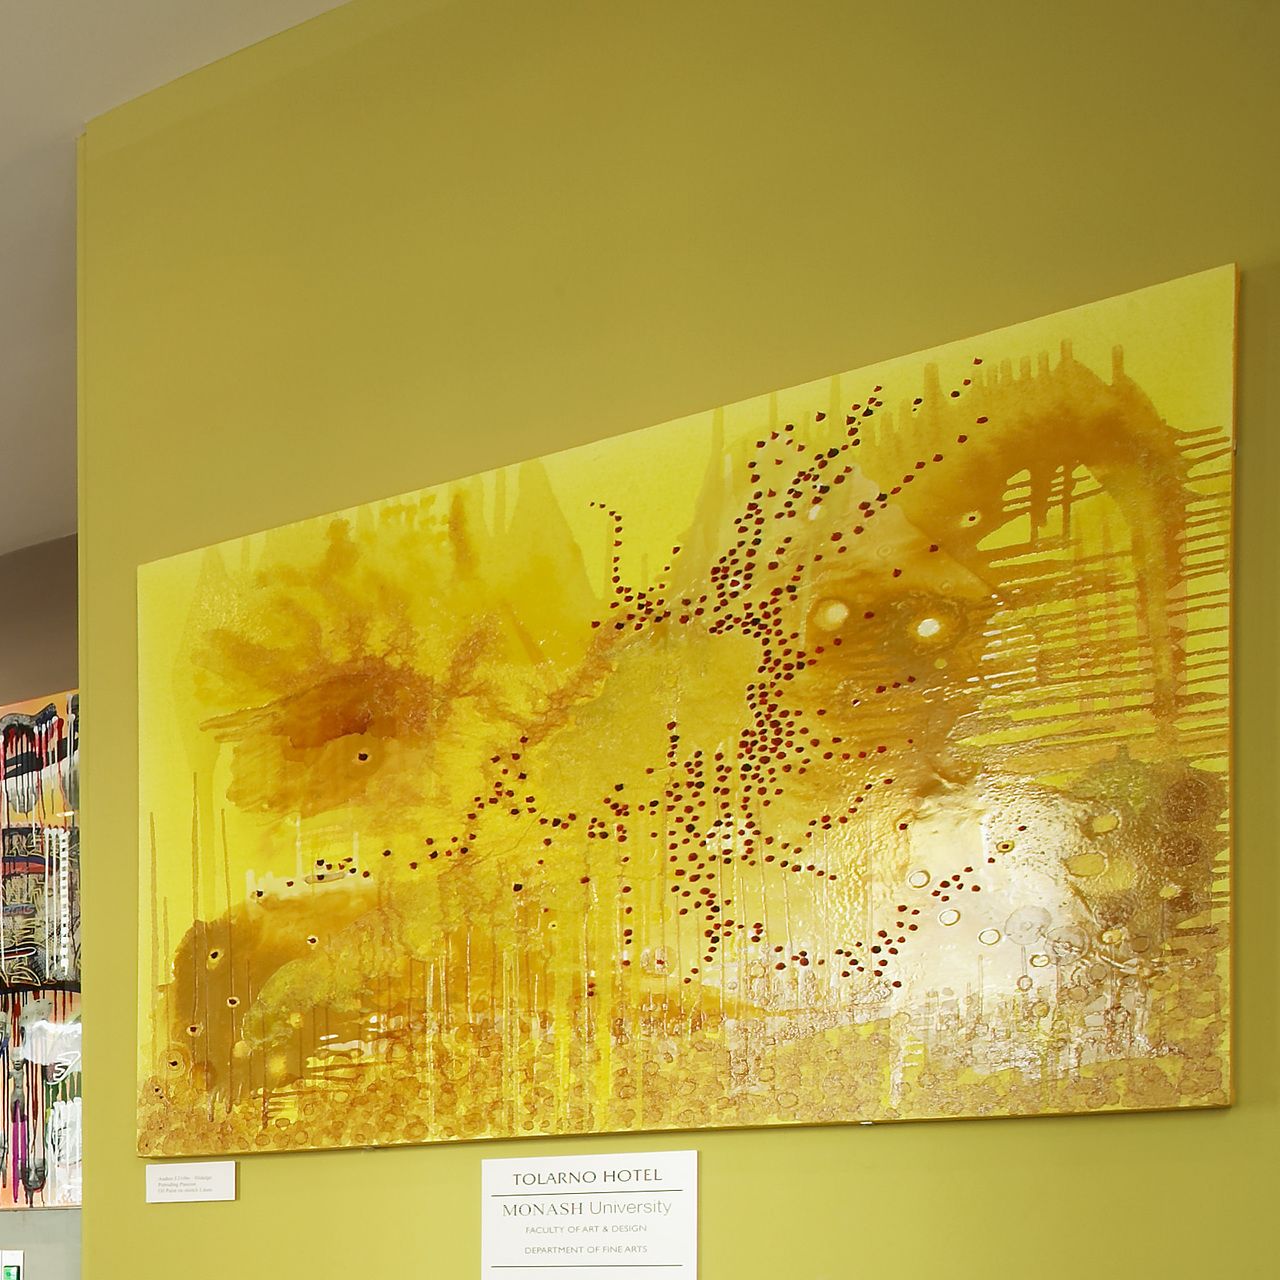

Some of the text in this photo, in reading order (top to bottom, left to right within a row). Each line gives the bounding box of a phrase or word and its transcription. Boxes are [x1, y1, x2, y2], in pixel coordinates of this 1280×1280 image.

[512, 1168, 663, 1186] TOLARNO HOTEL
[502, 1199, 672, 1218] MONASH University
[525, 1224, 647, 1235] FACULTY OF ART & DESIGN
[524, 1245, 648, 1255] DEPARTMENT OF FINE ARTS
